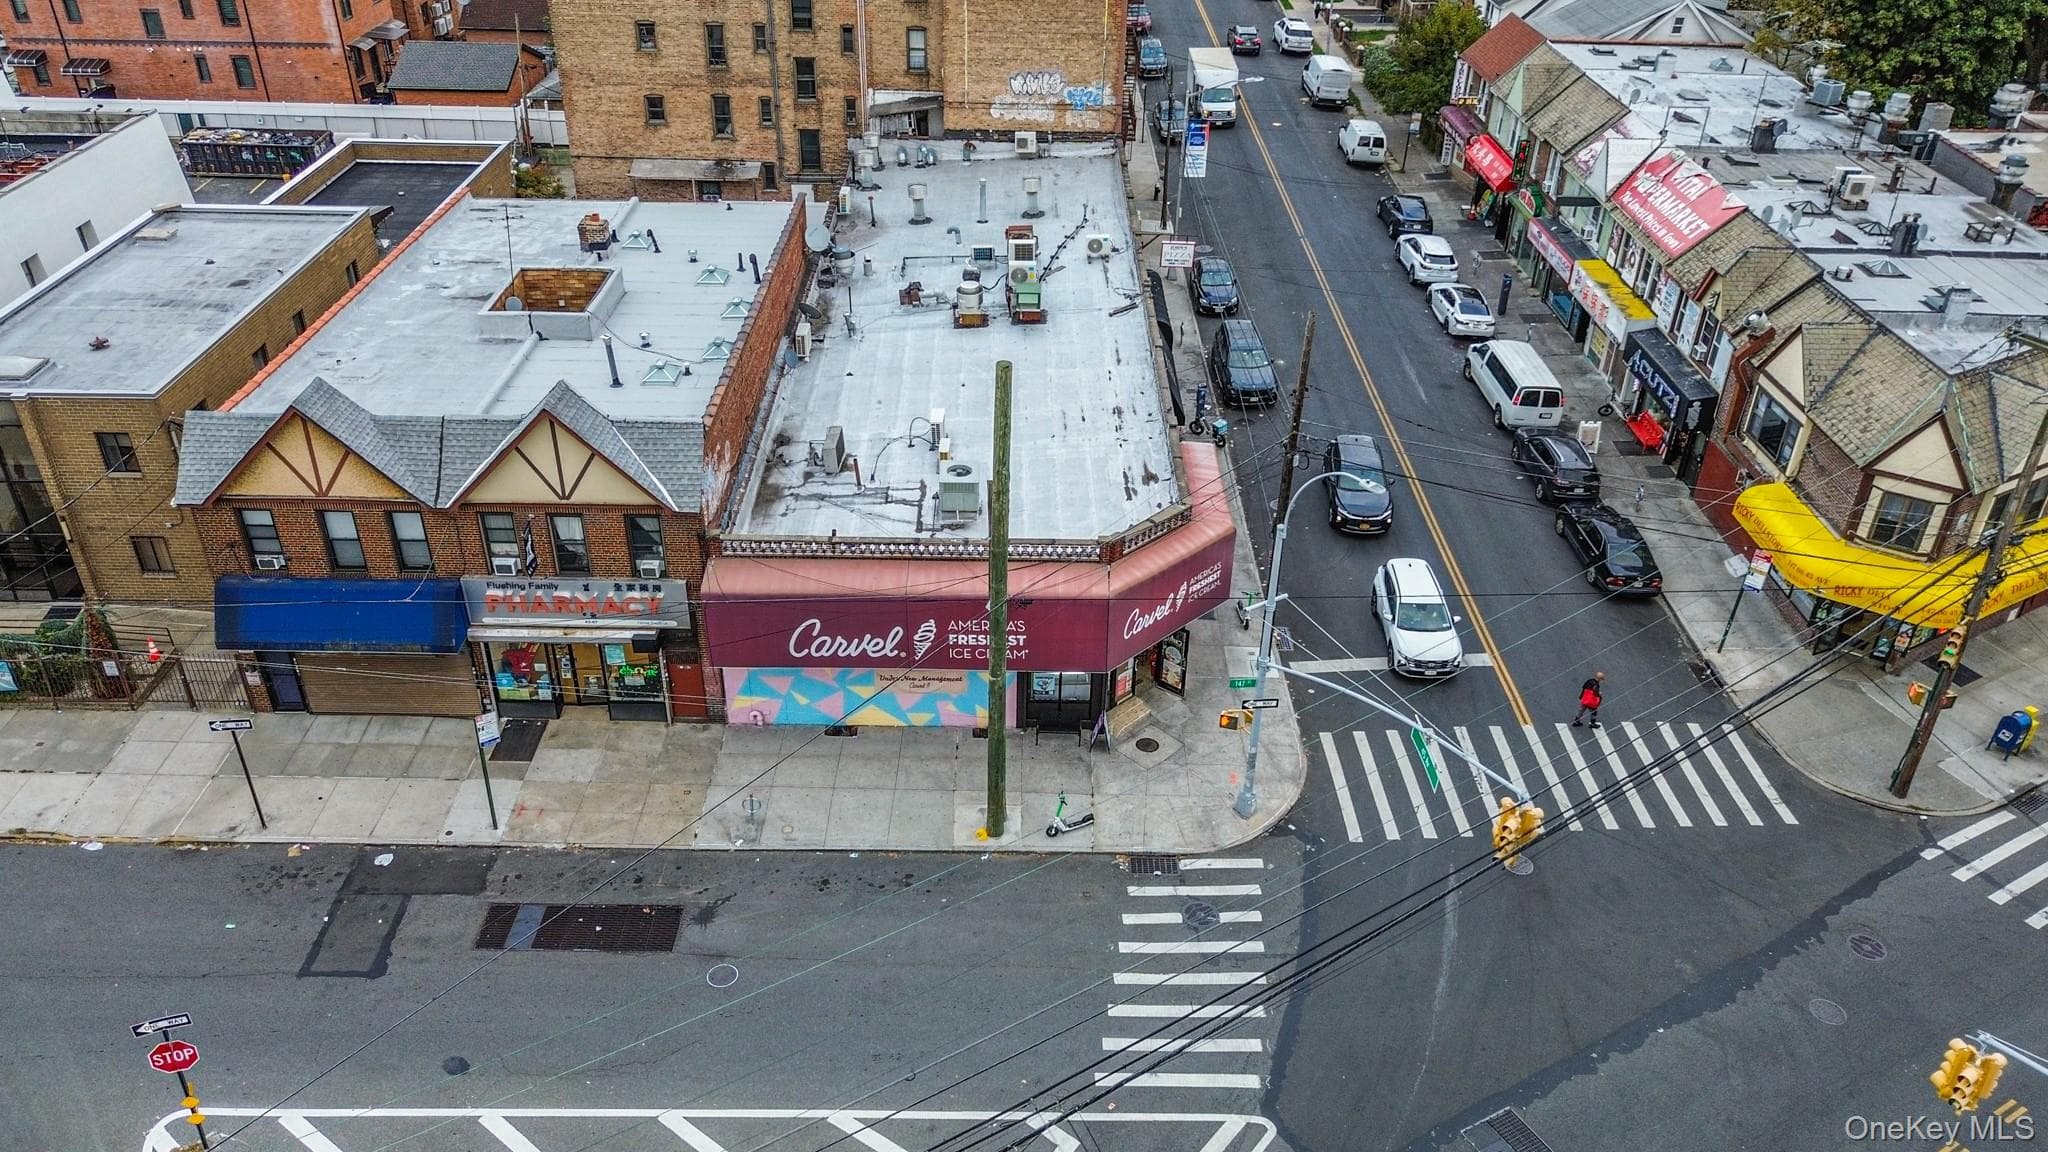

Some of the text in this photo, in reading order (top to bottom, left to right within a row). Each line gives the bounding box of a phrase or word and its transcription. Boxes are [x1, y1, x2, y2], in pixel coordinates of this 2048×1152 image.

[1619, 190, 1633, 204] The
[1628, 198, 1649, 219] Lowest
[1642, 213, 1661, 232] Prices
[486, 581, 559, 592] Flushing Family
[1189, 570, 1221, 594] FRESHEST
[1834, 585, 1863, 597] RICKY
[484, 590, 665, 616] PHARMACY
[1123, 592, 1173, 640] Carvel
[947, 619, 1026, 632] AMERA'S
[788, 618, 904, 658] Carvel
[948, 634, 1027, 646] FRESST
[949, 648, 1025, 659] ICE CAM
[919, 674, 963, 683] Management
[143, 1017, 185, 1032] ONE WAY
[152, 1048, 194, 1066] STOP
